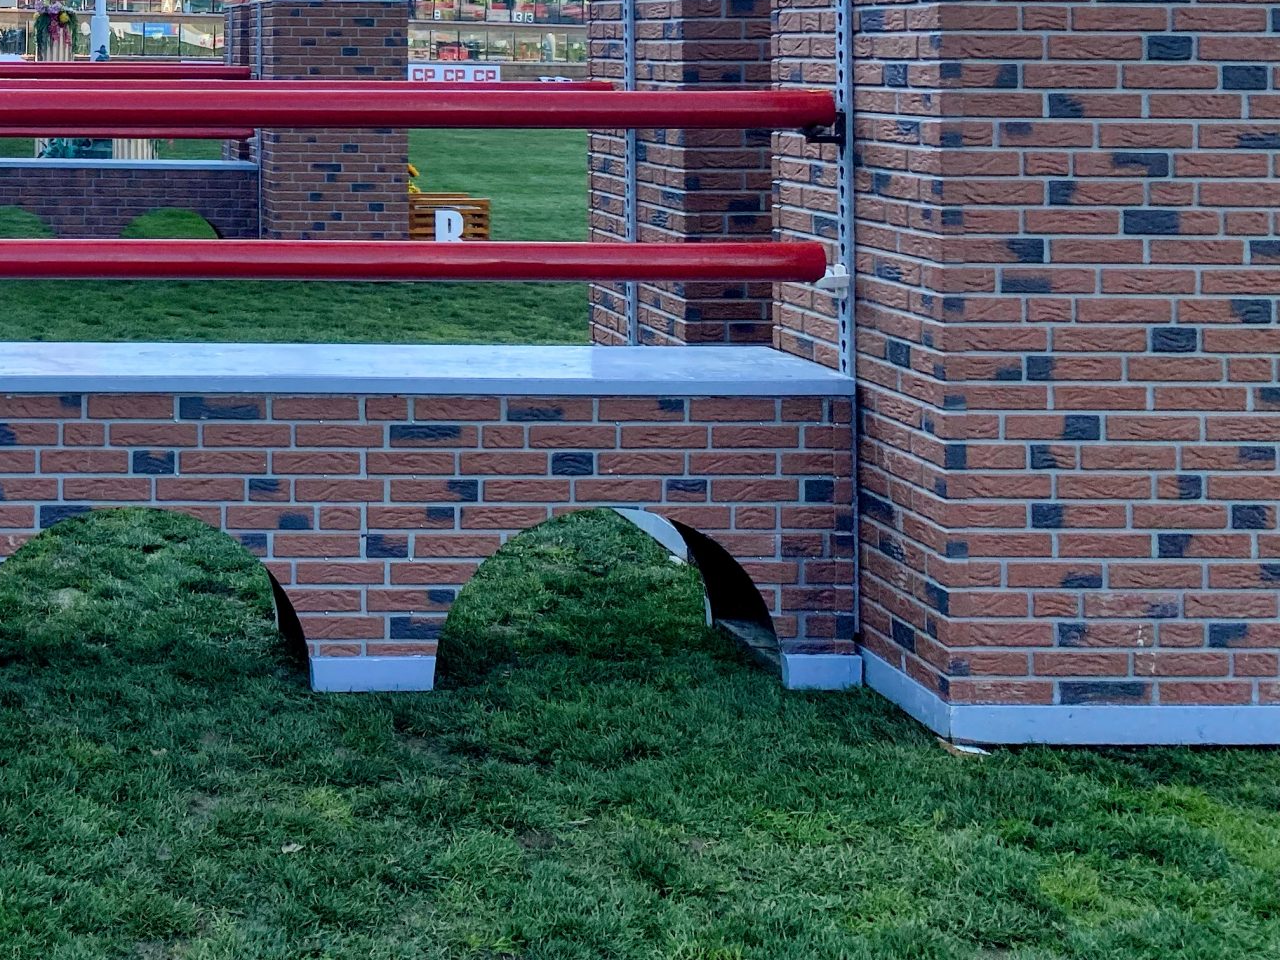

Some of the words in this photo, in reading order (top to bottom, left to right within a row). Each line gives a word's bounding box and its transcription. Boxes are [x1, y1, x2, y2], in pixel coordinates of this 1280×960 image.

[413, 68, 436, 81] CP
[443, 69, 466, 81] CP
[473, 69, 497, 81] CP
